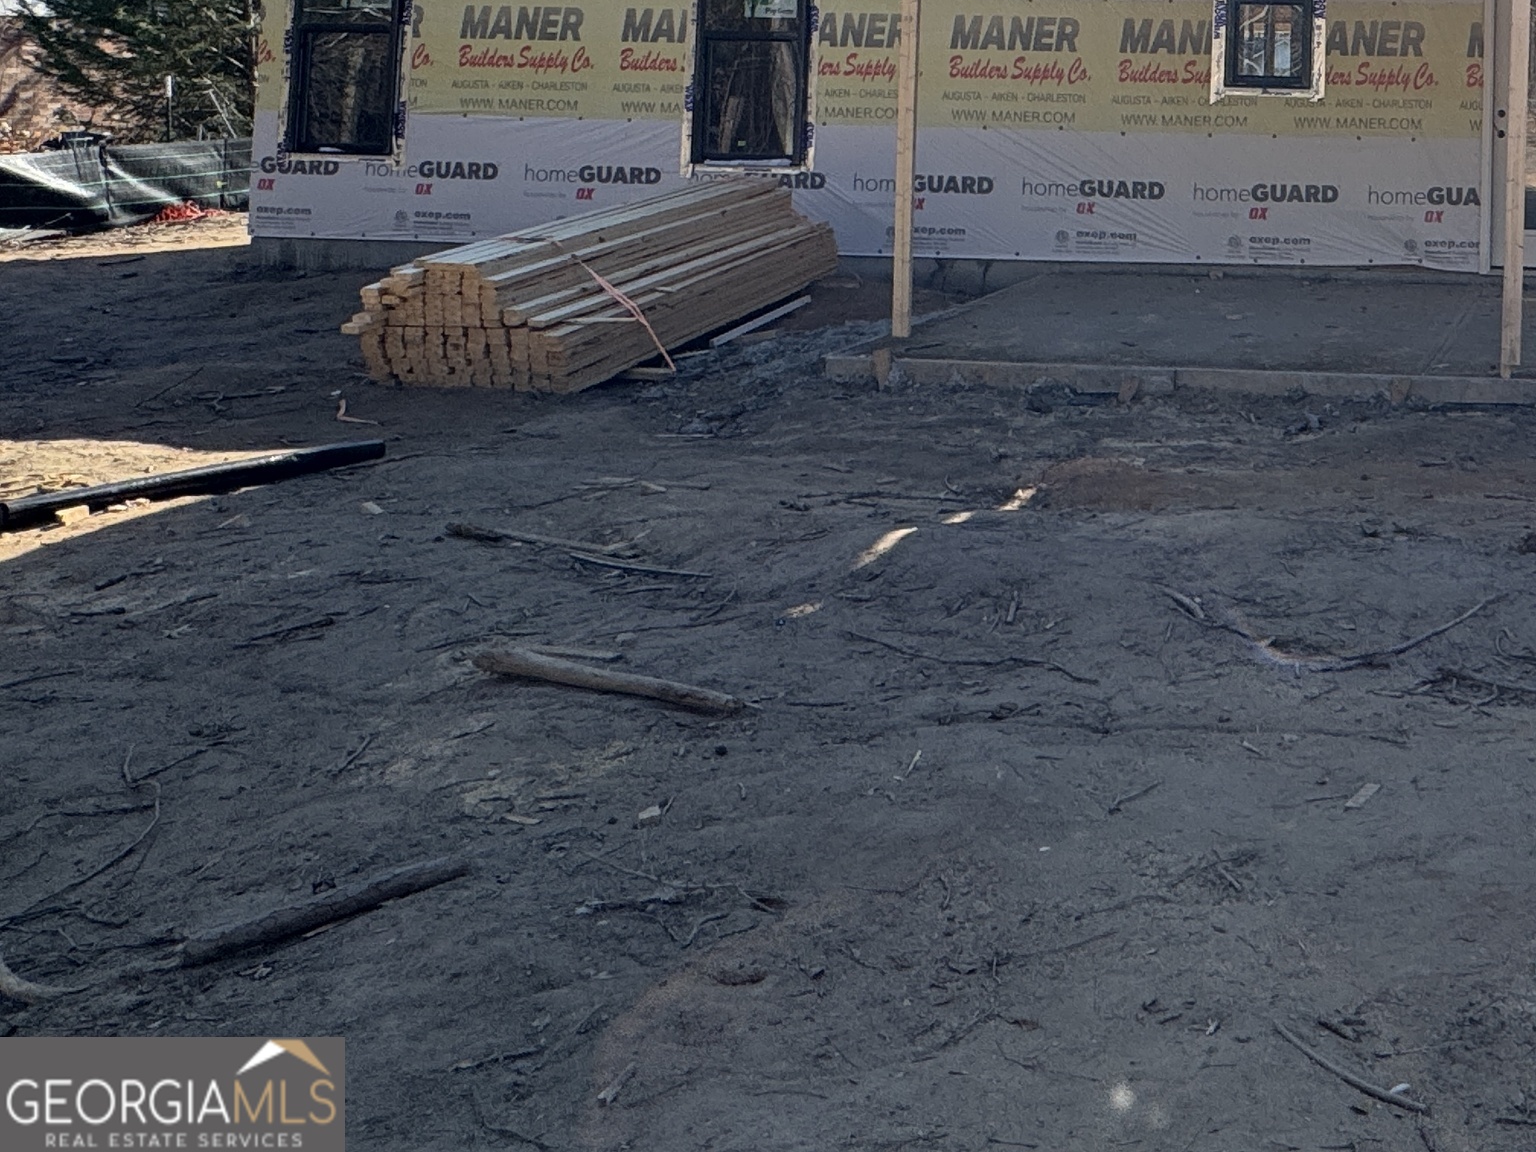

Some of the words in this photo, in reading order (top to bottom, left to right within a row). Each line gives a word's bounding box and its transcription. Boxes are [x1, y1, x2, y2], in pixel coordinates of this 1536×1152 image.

[460, 5, 585, 42] MANER
[818, 11, 903, 49] ANER
[950, 14, 1081, 53] MANER
[1118, 18, 1212, 55] MAN
[1326, 20, 1426, 58] ANER
[411, 43, 434, 69] Co.
[459, 45, 514, 70] Builders
[517, 45, 568, 74] Supply
[572, 46, 595, 73] Co.
[619, 47, 678, 72] Builders
[843, 52, 896, 83] Supply
[948, 54, 1008, 81] Builders
[1011, 55, 1065, 86] Supply
[1067, 56, 1092, 85] Co.
[1117, 58, 1180, 85] Builders
[1353, 61, 1411, 92] Supply
[1413, 62, 1439, 91] Co.
[451, 79, 490, 90] AUGUSTA
[531, 80, 588, 92] CHARLESTON
[612, 82, 652, 94] AUGUSTA
[660, 83, 681, 94] AIKE
[824, 89, 851, 100] AIKEN
[859, 89, 899, 100] CHARLES
[942, 91, 982, 102] AUGUSTA
[991, 92, 1019, 102] AIKEN
[1027, 93, 1087, 104] CHARLESTON
[1112, 95, 1153, 106] AUGUSTA
[1162, 96, 1189, 106] AIKEN
[1335, 99, 1365, 109] AIKEN
[1373, 99, 1434, 110] CHARLESTON
[524, 163, 662, 184] homeGUARD
[853, 171, 994, 194] homGUARD
[257, 179, 275, 191] OX
[415, 183, 434, 196] OX
[575, 188, 596, 201] OX
[1022, 177, 1166, 200] homeGUARD
[1193, 182, 1340, 204] homeGUARD
[1367, 185, 1481, 206] homeGUA
[414, 210, 472, 222] oxep.com
[1075, 202, 1097, 215] OX
[1248, 207, 1269, 221] OX
[1424, 210, 1445, 224] OX
[913, 226, 966, 239] xep.com
[1248, 234, 1311, 246] oxep.com
